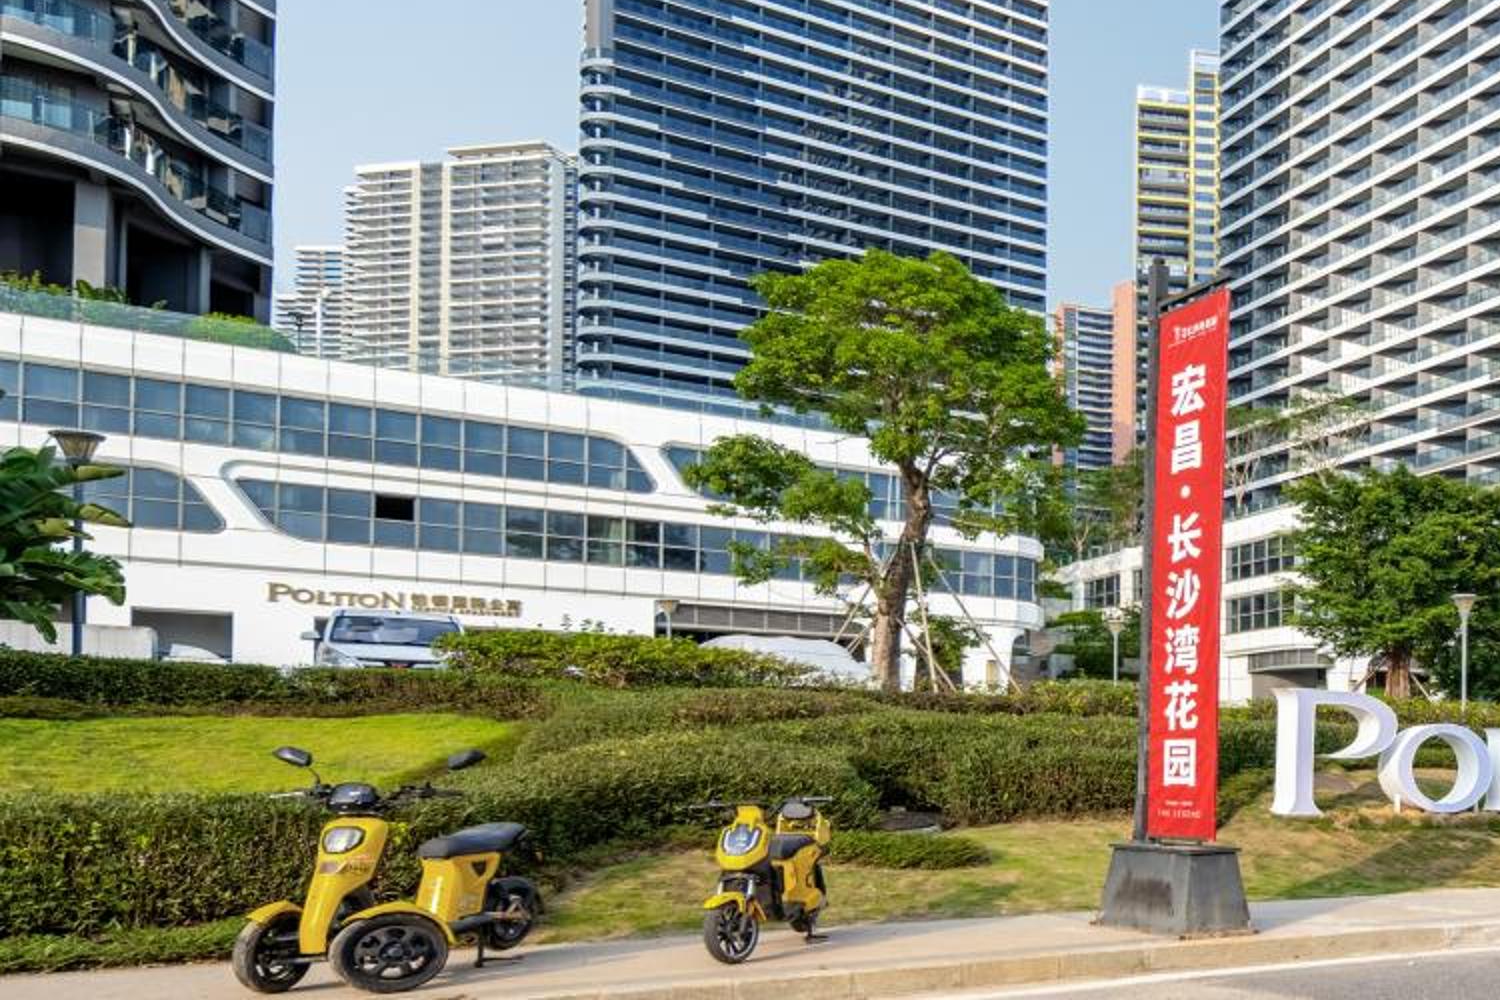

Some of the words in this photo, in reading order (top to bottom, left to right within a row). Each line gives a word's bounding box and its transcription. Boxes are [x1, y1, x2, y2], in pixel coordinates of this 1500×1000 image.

[1163, 364, 1206, 787] 宏昌·长沙湾花园
